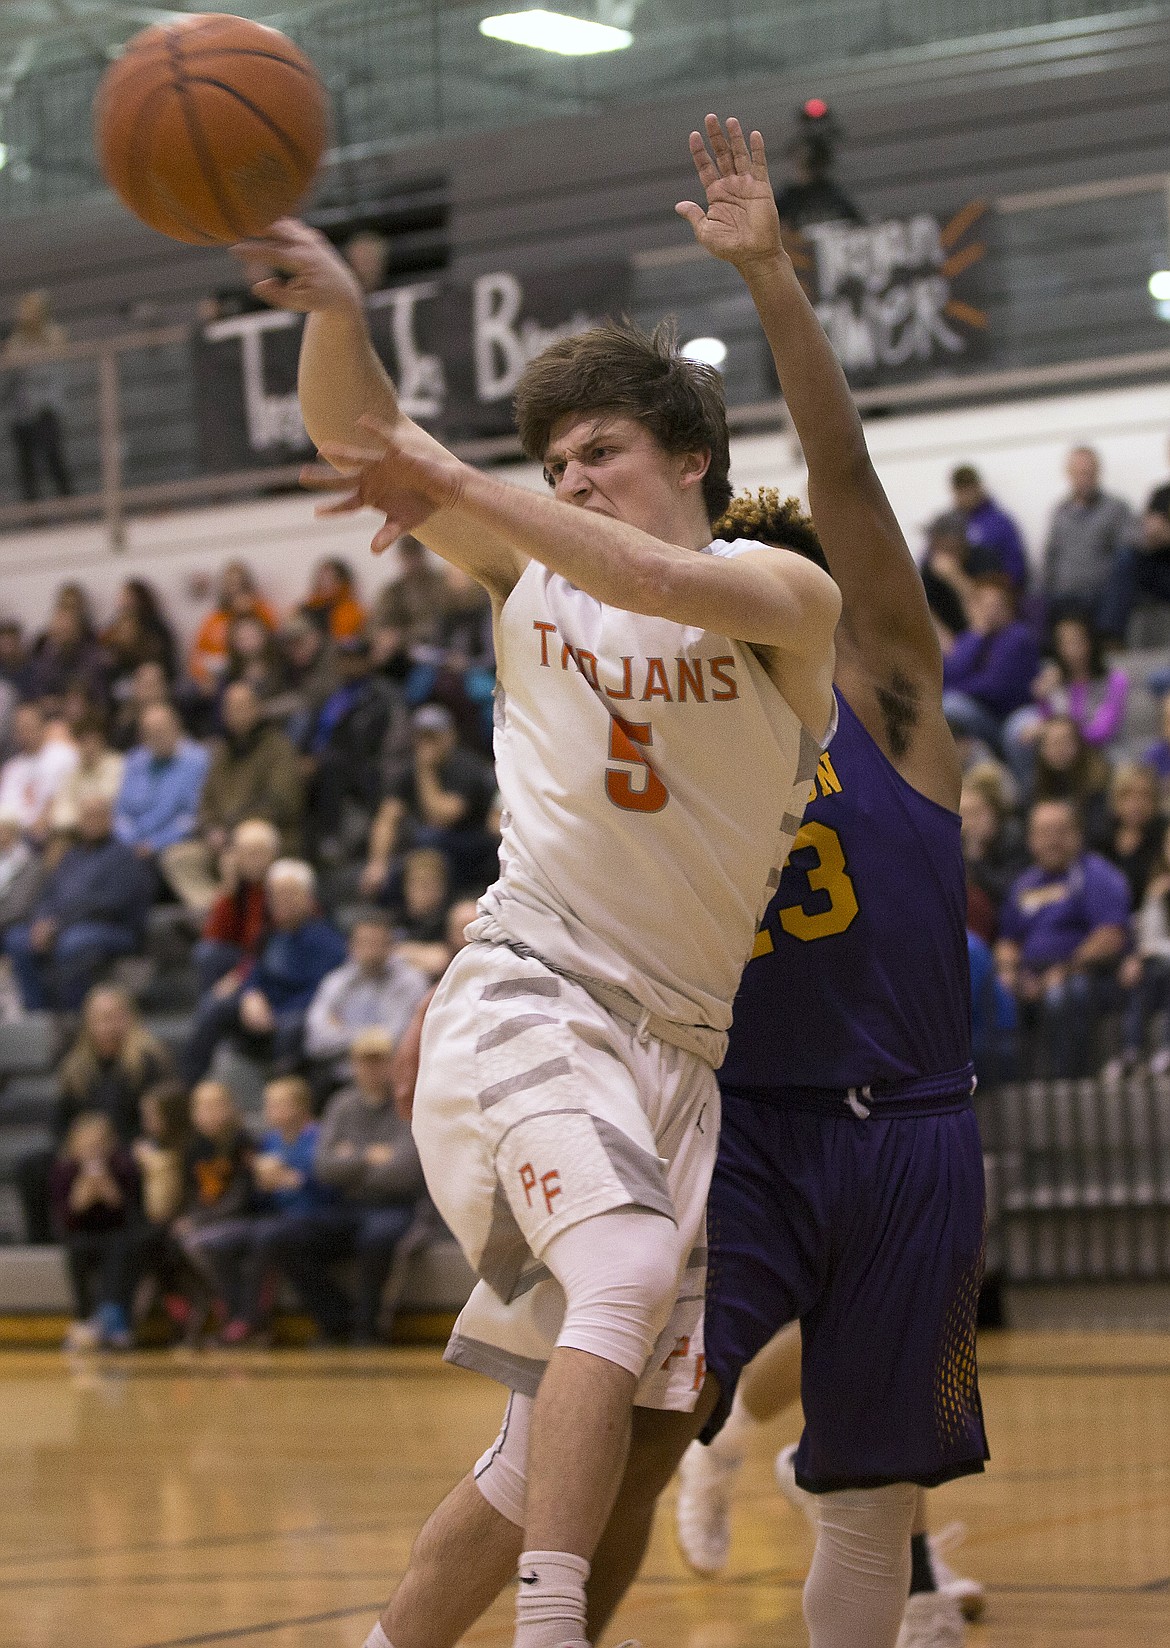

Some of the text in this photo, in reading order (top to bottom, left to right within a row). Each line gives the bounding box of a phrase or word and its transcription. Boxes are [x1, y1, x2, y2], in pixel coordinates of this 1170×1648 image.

[605, 713, 670, 814] 5
[751, 821, 859, 959] 3
[519, 1163, 562, 1215] PF
